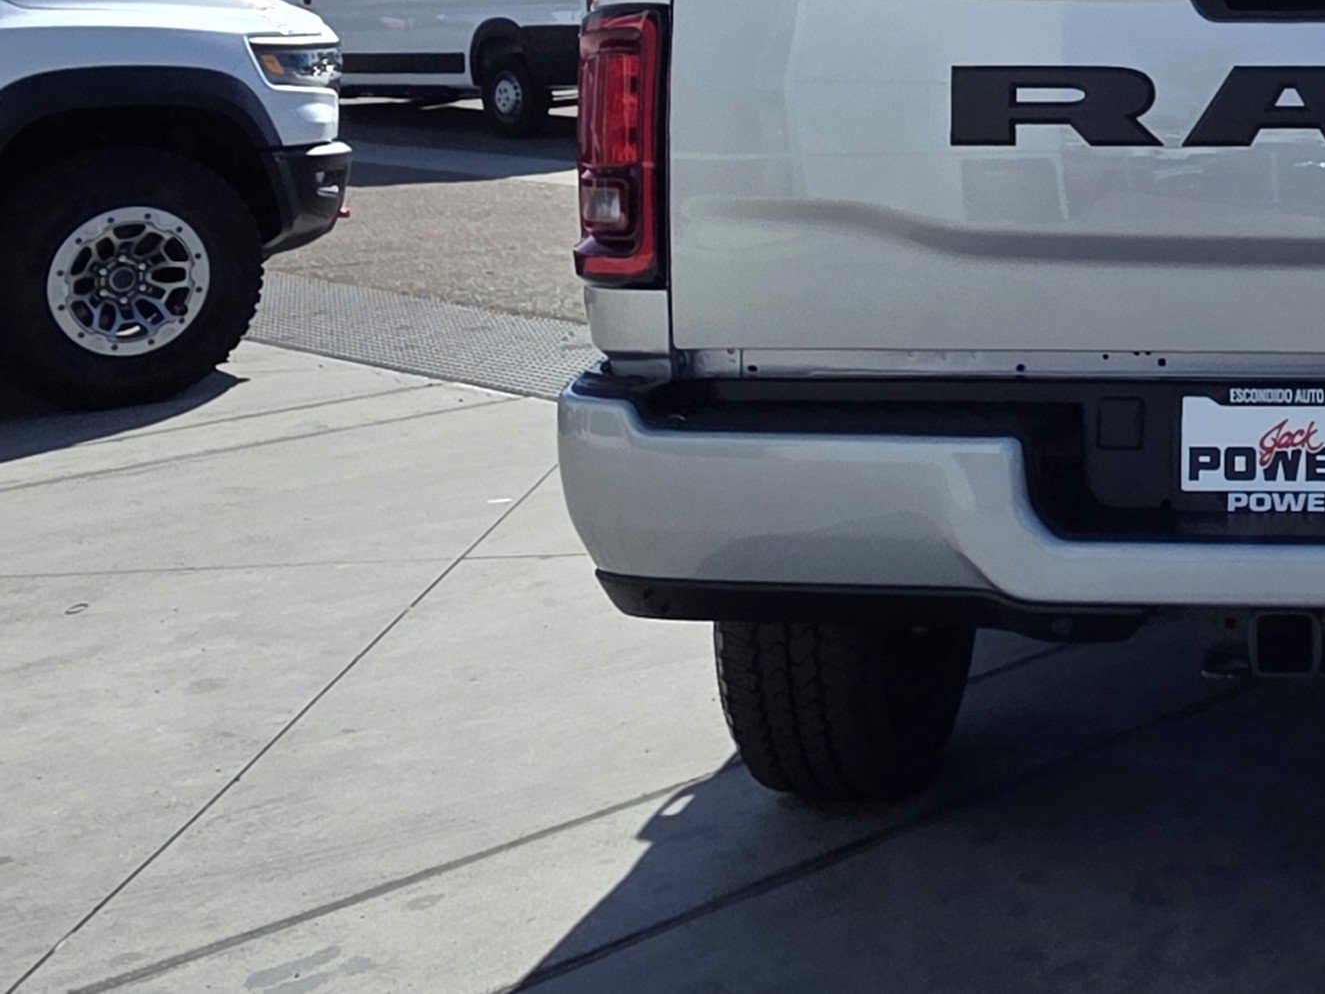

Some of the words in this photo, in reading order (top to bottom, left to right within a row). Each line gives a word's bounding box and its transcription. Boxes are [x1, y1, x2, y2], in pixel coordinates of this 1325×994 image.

[1229, 388, 1293, 403] ESCONDIDO
[1294, 388, 1325, 403] AUTO
[1258, 418, 1324, 467] Jack
